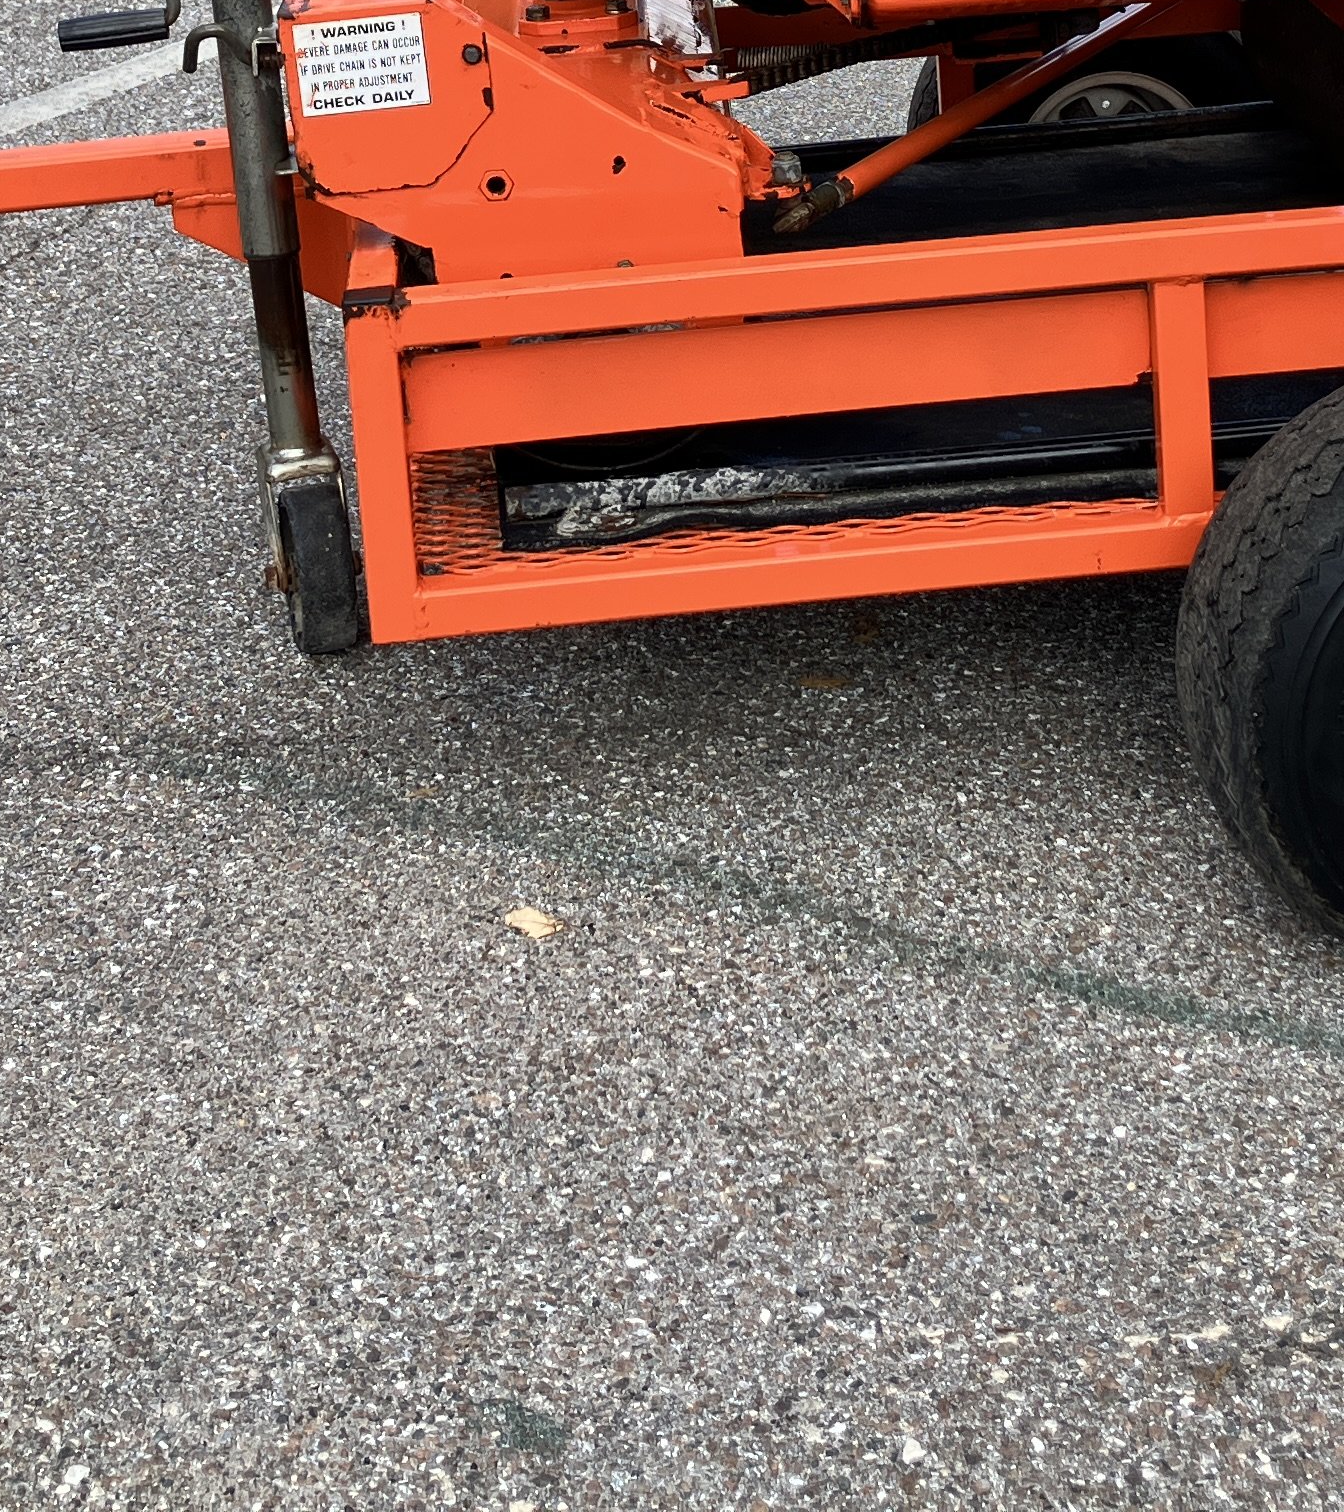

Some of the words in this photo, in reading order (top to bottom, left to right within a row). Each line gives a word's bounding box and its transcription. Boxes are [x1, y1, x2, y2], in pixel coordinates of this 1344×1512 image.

[320, 21, 396, 39] WARNING
[333, 41, 369, 56] DAMAGE
[372, 38, 390, 51] CAN
[392, 35, 421, 49] OCCUR
[300, 64, 309, 76] IF
[311, 62, 337, 76] DRIVE
[339, 59, 365, 72] CHAIN
[368, 58, 377, 69] IS
[380, 55, 397, 67] NOT
[400, 53, 422, 65] KEPT
[310, 81, 320, 93] IN
[322, 78, 355, 92] PROPER
[313, 94, 366, 110] CHECK
[372, 89, 415, 104] DAILY
